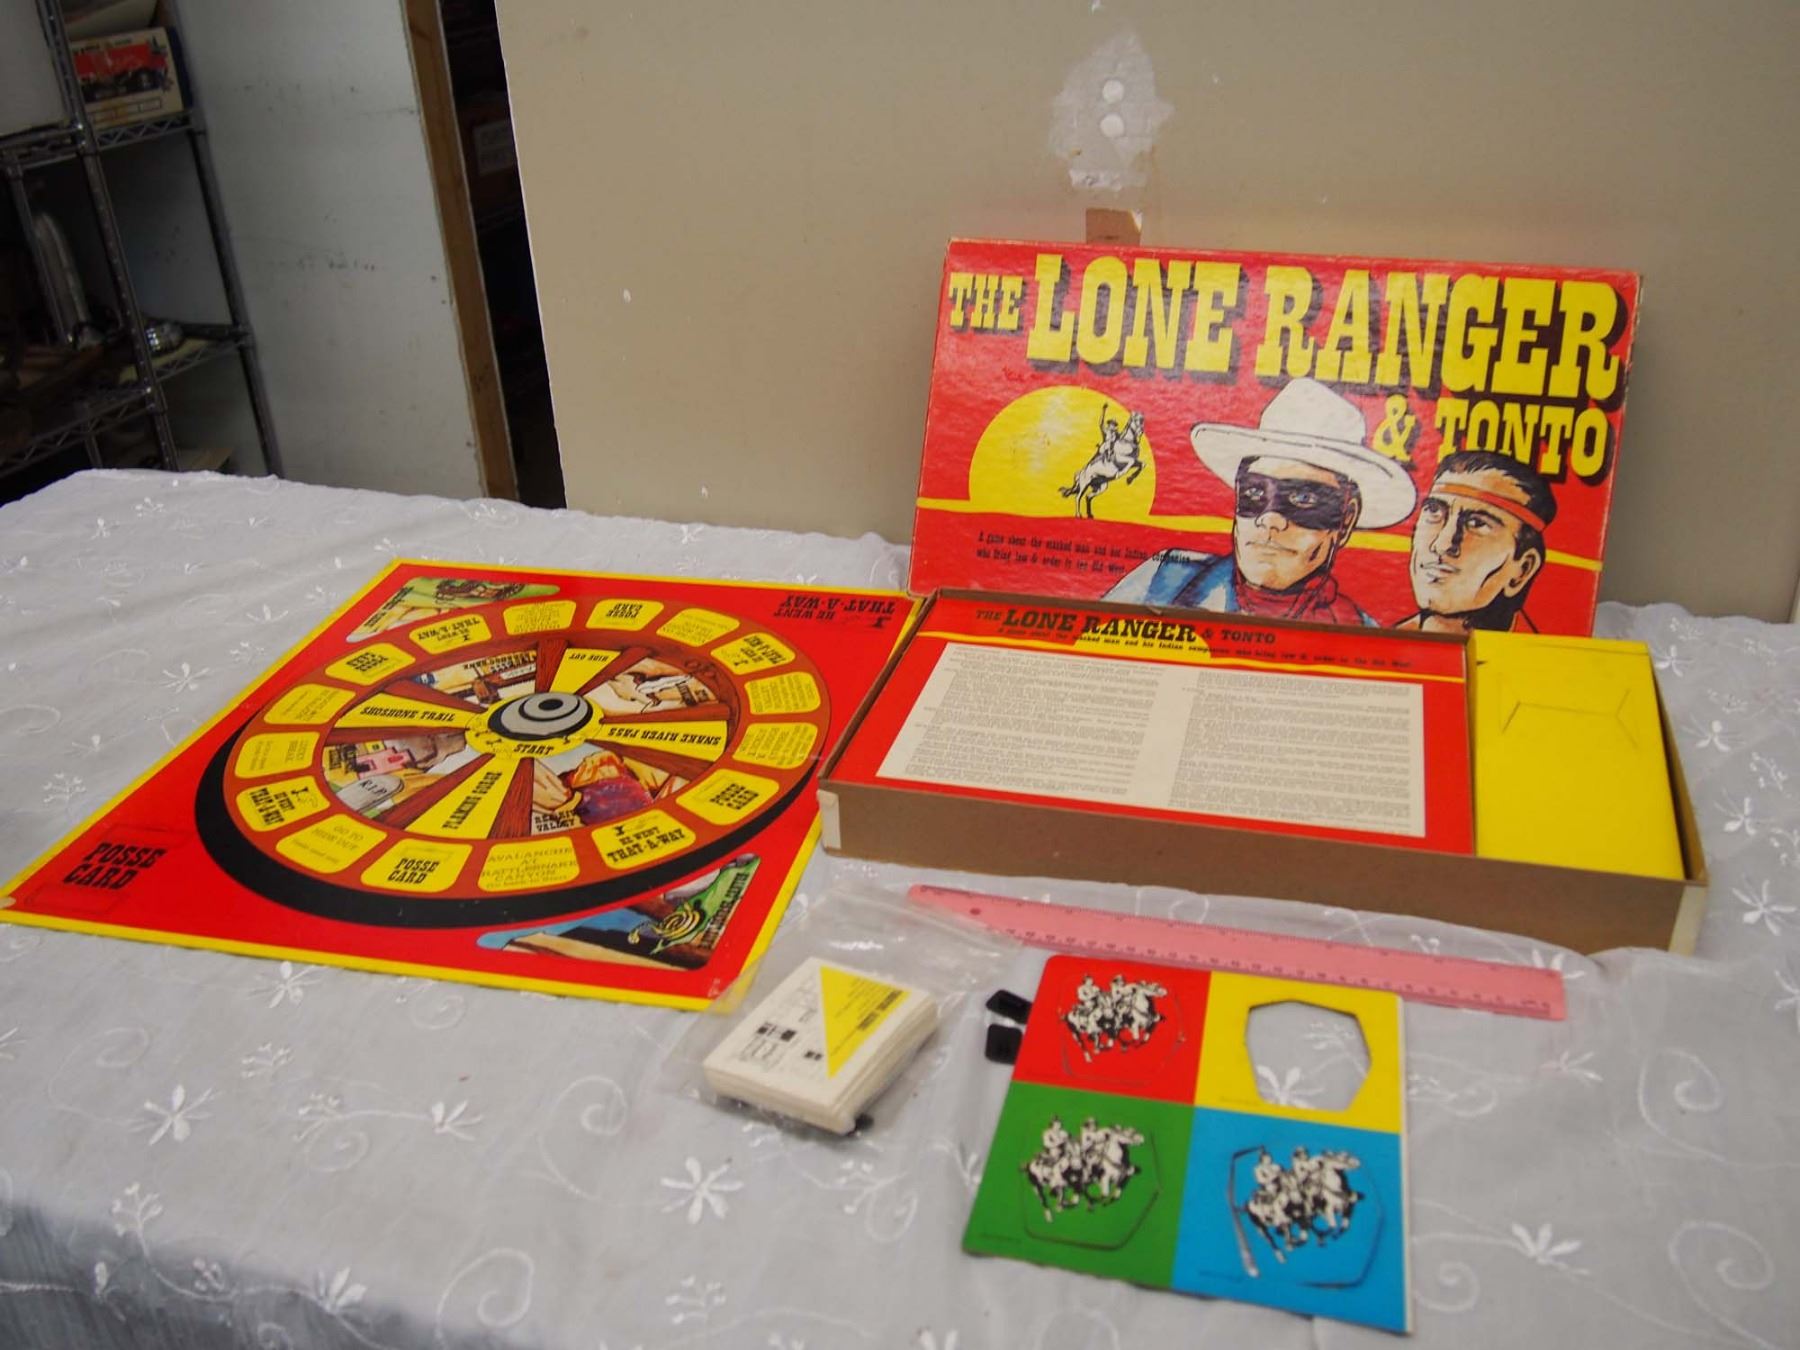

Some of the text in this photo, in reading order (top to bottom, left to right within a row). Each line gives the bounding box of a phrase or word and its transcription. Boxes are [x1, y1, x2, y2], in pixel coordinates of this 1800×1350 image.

[948, 253, 1621, 400] THE LONE RANGER
[1372, 394, 1611, 478] & TONTO
[605, 609, 640, 620] POSSE
[612, 602, 644, 612] CARD
[774, 606, 837, 621] HE WENT
[976, 608, 1277, 645] THE LONE RANGER & TONTO
[1124, 639, 1139, 648] and
[567, 651, 611, 663] HIDE OUT
[359, 705, 456, 723] SHOSHONE TRAIL
[607, 726, 722, 747] SNAKE RIVER PASS
[512, 742, 555, 757] START
[635, 827, 661, 841] WENT
[84, 842, 168, 868] POSSE
[395, 856, 441, 872] POSSE
[63, 863, 139, 890] CARD
[387, 867, 429, 885] CARD
